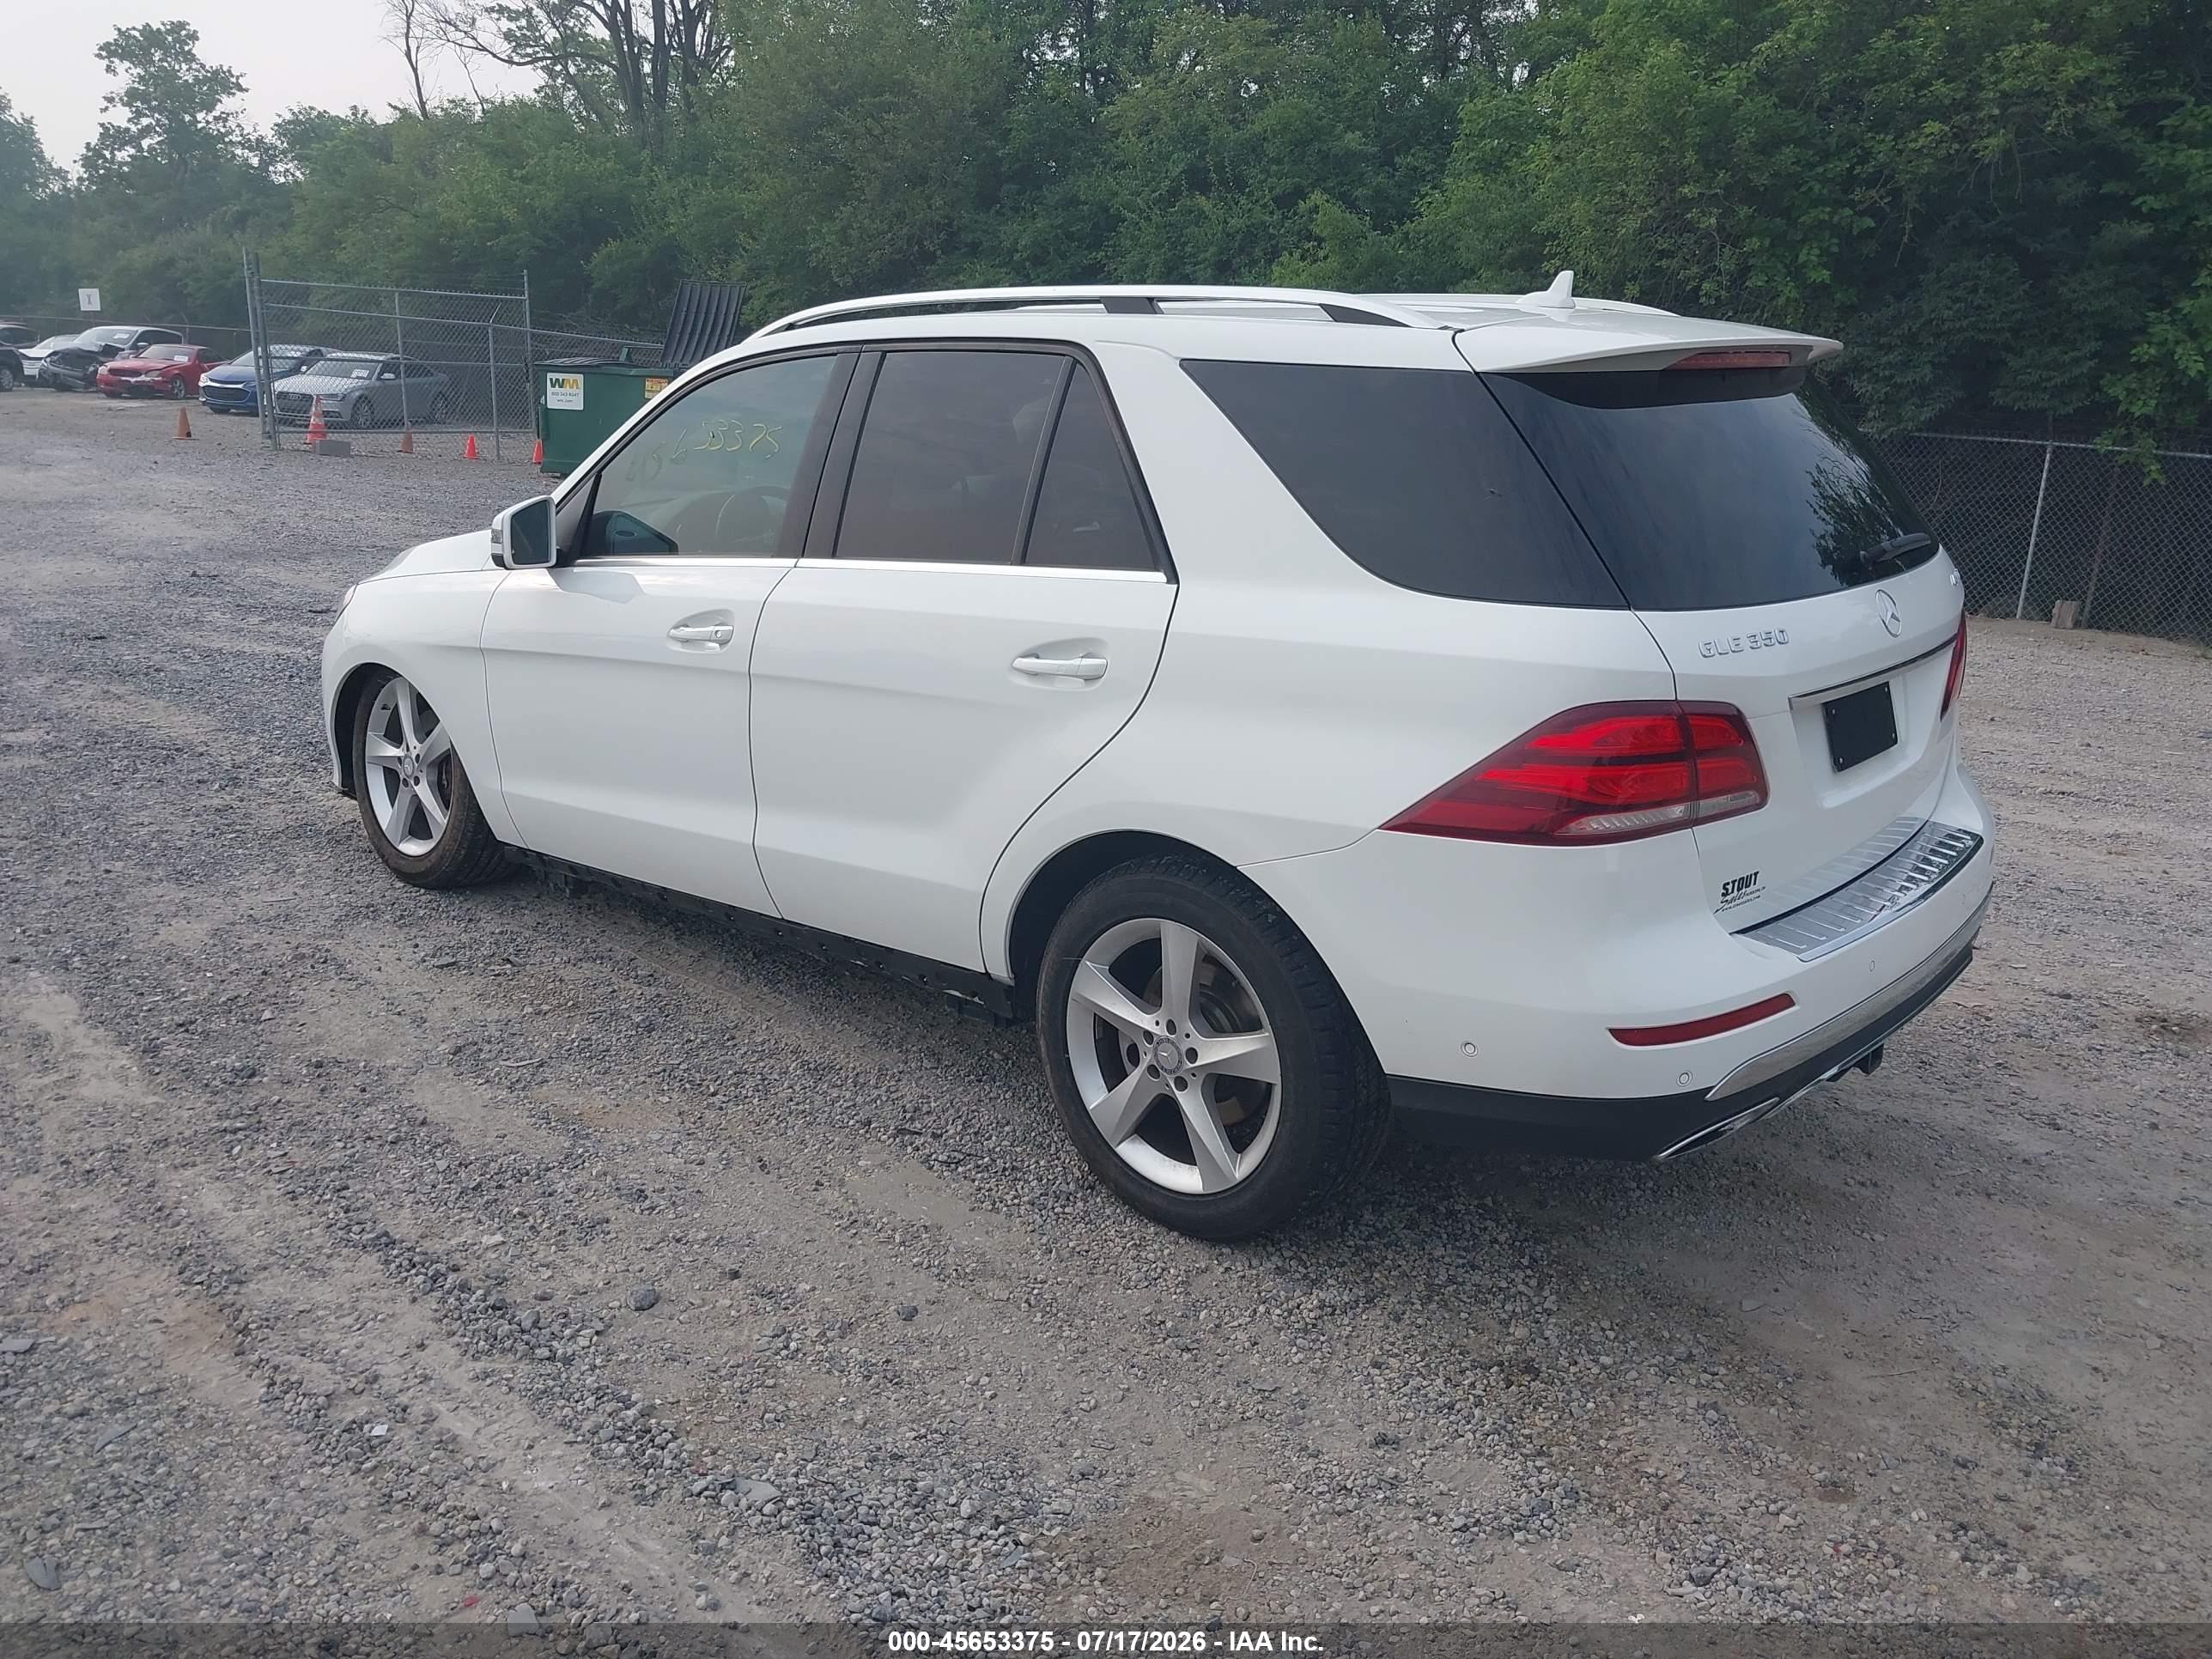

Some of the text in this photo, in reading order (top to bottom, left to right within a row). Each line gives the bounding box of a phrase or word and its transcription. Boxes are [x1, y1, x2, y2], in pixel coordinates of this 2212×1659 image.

[550, 377, 580, 389] WM
[1698, 629, 1790, 659] GLE 350
[1721, 870, 1759, 897] STOUT
